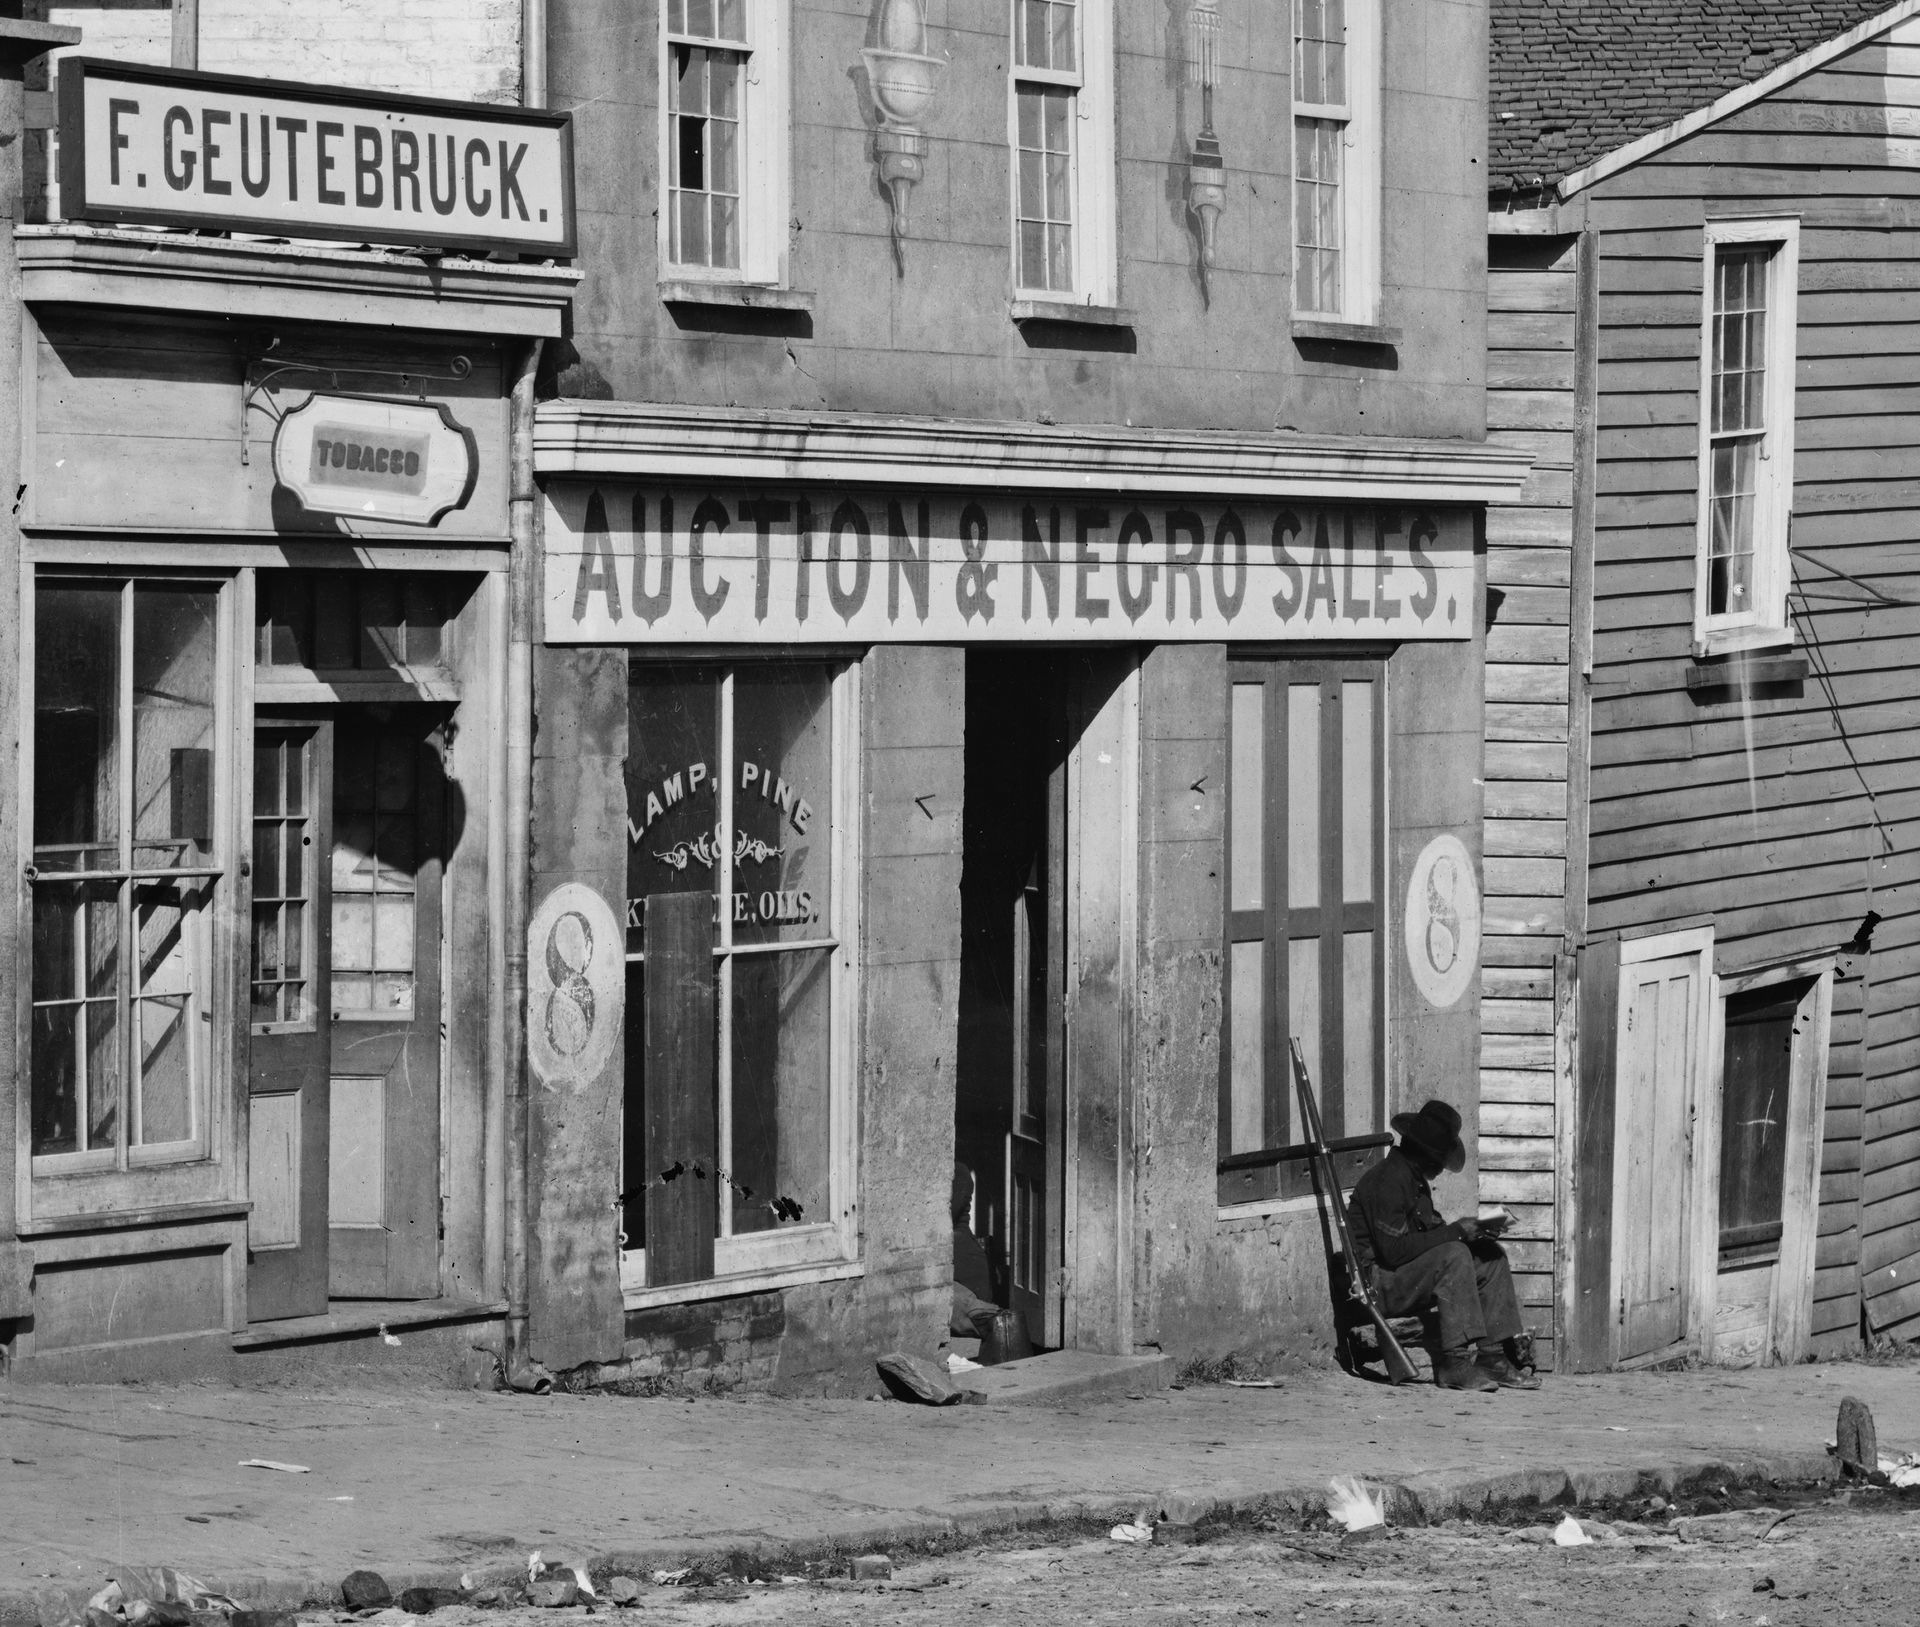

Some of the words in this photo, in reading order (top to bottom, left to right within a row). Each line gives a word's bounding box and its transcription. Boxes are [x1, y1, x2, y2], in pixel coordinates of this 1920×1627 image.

[109, 98, 146, 188] F.
[317, 439, 419, 477] TOBACCO
[572, 487, 930, 630] AUCTION
[956, 500, 999, 628] &
[1021, 502, 1247, 628] NEGRO
[1271, 508, 1456, 627] SALES.
[627, 762, 718, 844] LAMP,
[741, 761, 814, 836] PINE
[1426, 855, 1461, 974] 8
[545, 911, 595, 1057] 8
